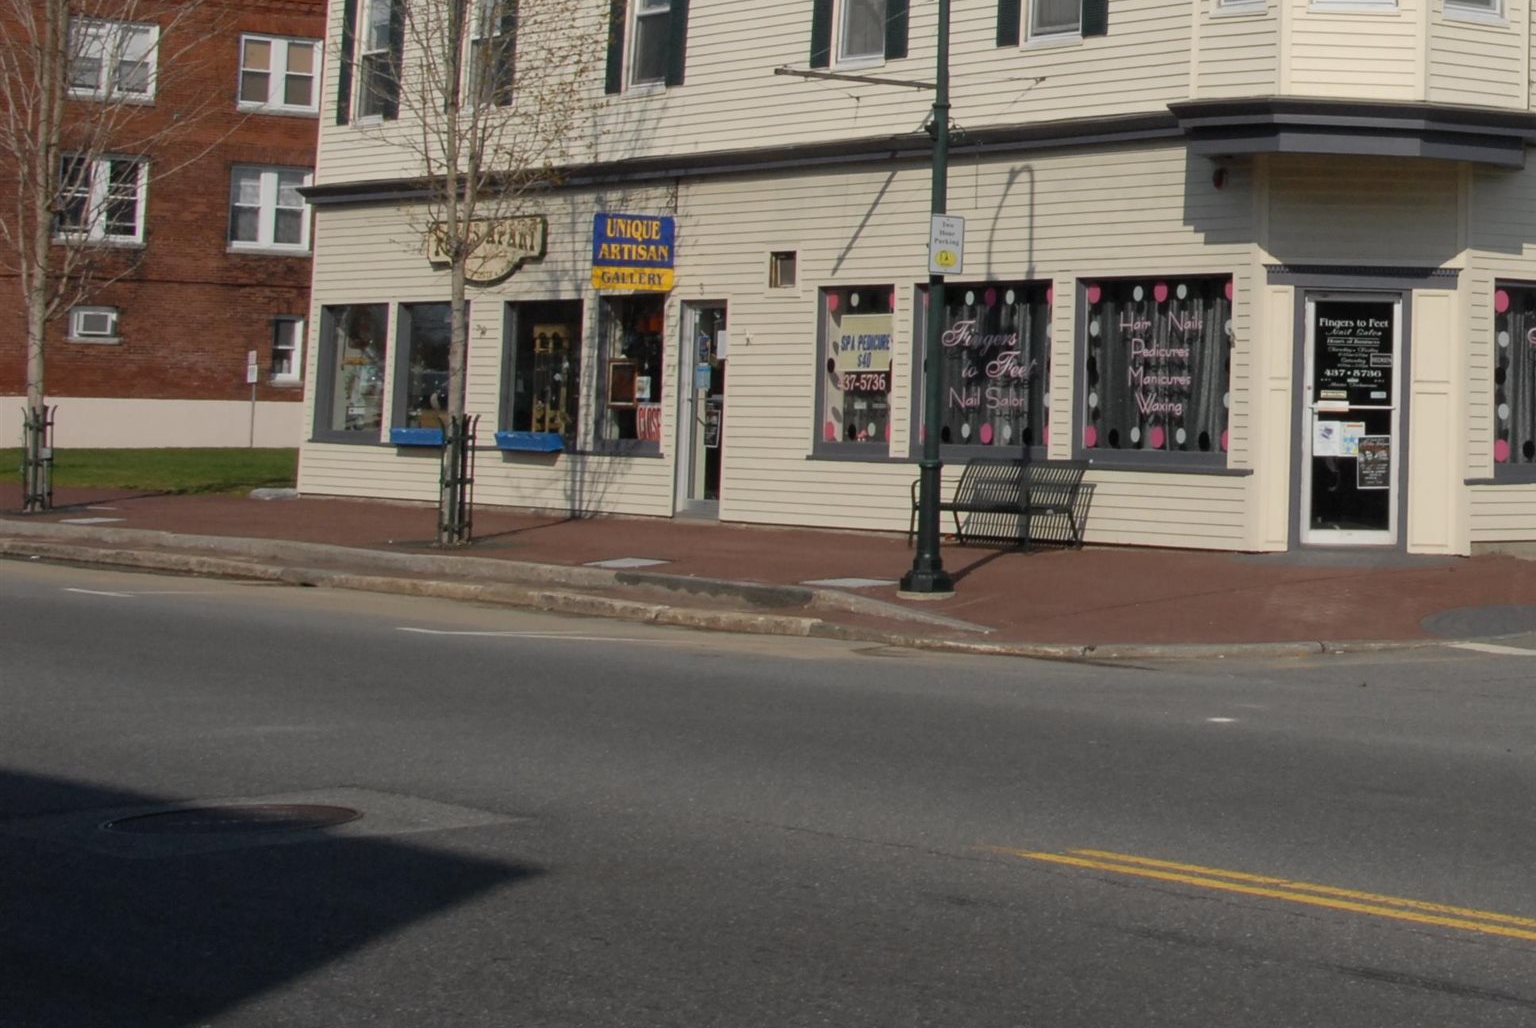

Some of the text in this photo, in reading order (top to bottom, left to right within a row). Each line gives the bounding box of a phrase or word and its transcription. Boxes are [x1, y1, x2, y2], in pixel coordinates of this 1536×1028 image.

[606, 218, 661, 241] UNIQUE
[599, 243, 669, 262] ARTISAN
[934, 237, 960, 247] Parking
[601, 271, 664, 286] GALLERY
[1119, 310, 1203, 332] Hair Nails
[1319, 317, 1355, 328] Fingers
[1369, 318, 1389, 328] Feet
[841, 335, 856, 351] SPA
[941, 320, 1018, 356] Fingers
[1131, 338, 1190, 359] Pedicures
[961, 359, 979, 378] to
[1128, 366, 1192, 387] Manicures
[949, 386, 981, 408] Nail
[1135, 392, 1183, 416] Waxing
